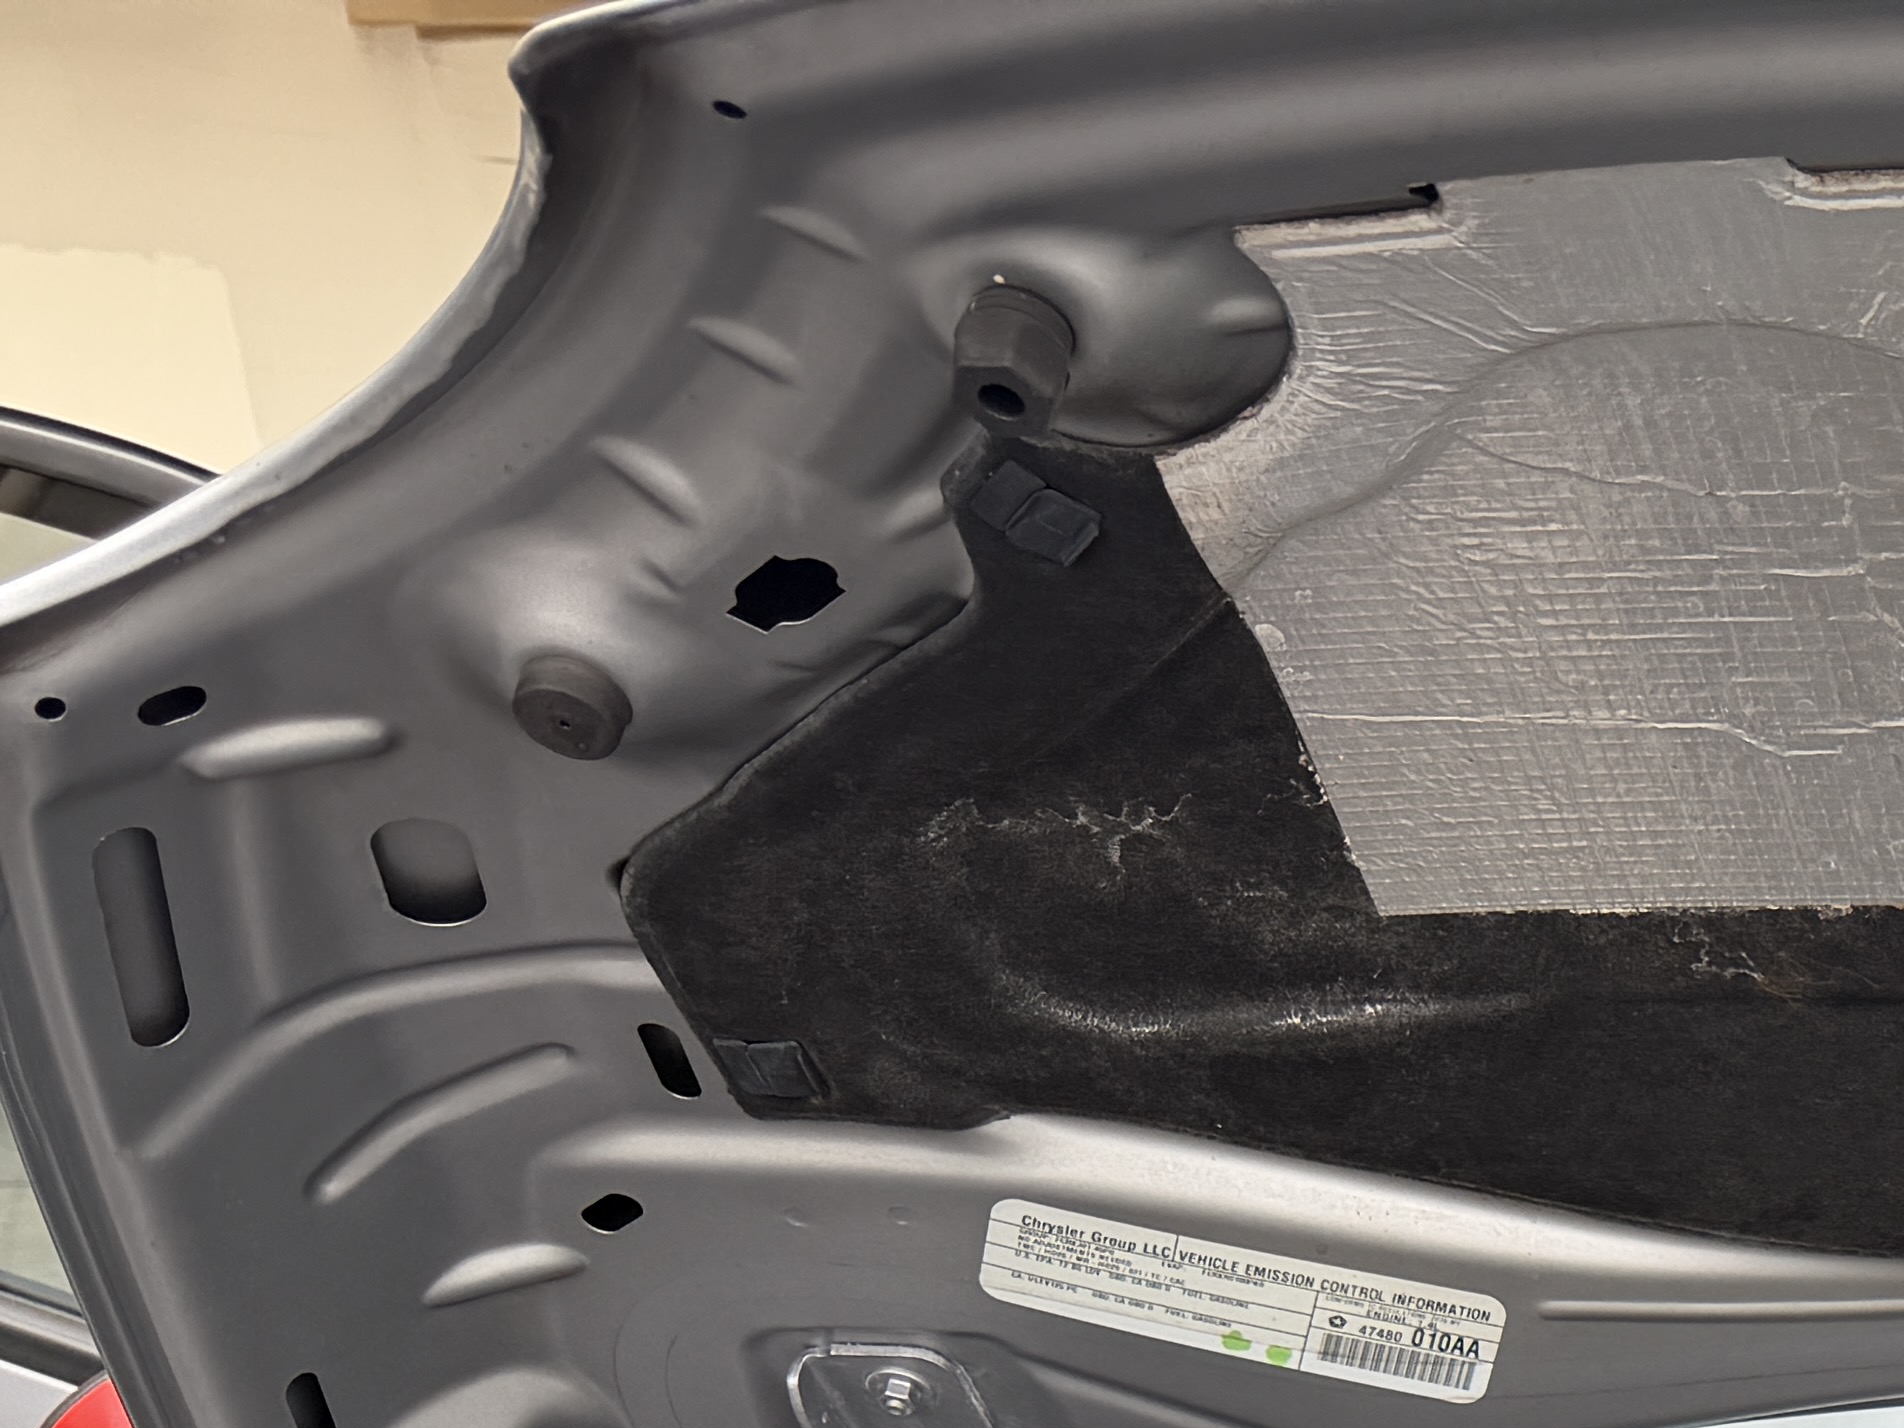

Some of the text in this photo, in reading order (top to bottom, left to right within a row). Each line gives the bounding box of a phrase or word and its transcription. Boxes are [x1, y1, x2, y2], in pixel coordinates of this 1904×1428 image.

[1019, 1214, 1086, 1240] Chrysler
[1089, 1231, 1138, 1253] Group
[1142, 1243, 1171, 1258] LLC
[1176, 1250, 1239, 1273] VEHICLE
[1244, 1264, 1316, 1287] EMISSION
[1319, 1278, 1387, 1302] CONTROL
[1390, 1291, 1492, 1323] INFORMATION
[1357, 1324, 1482, 1359] 47480 010AA
